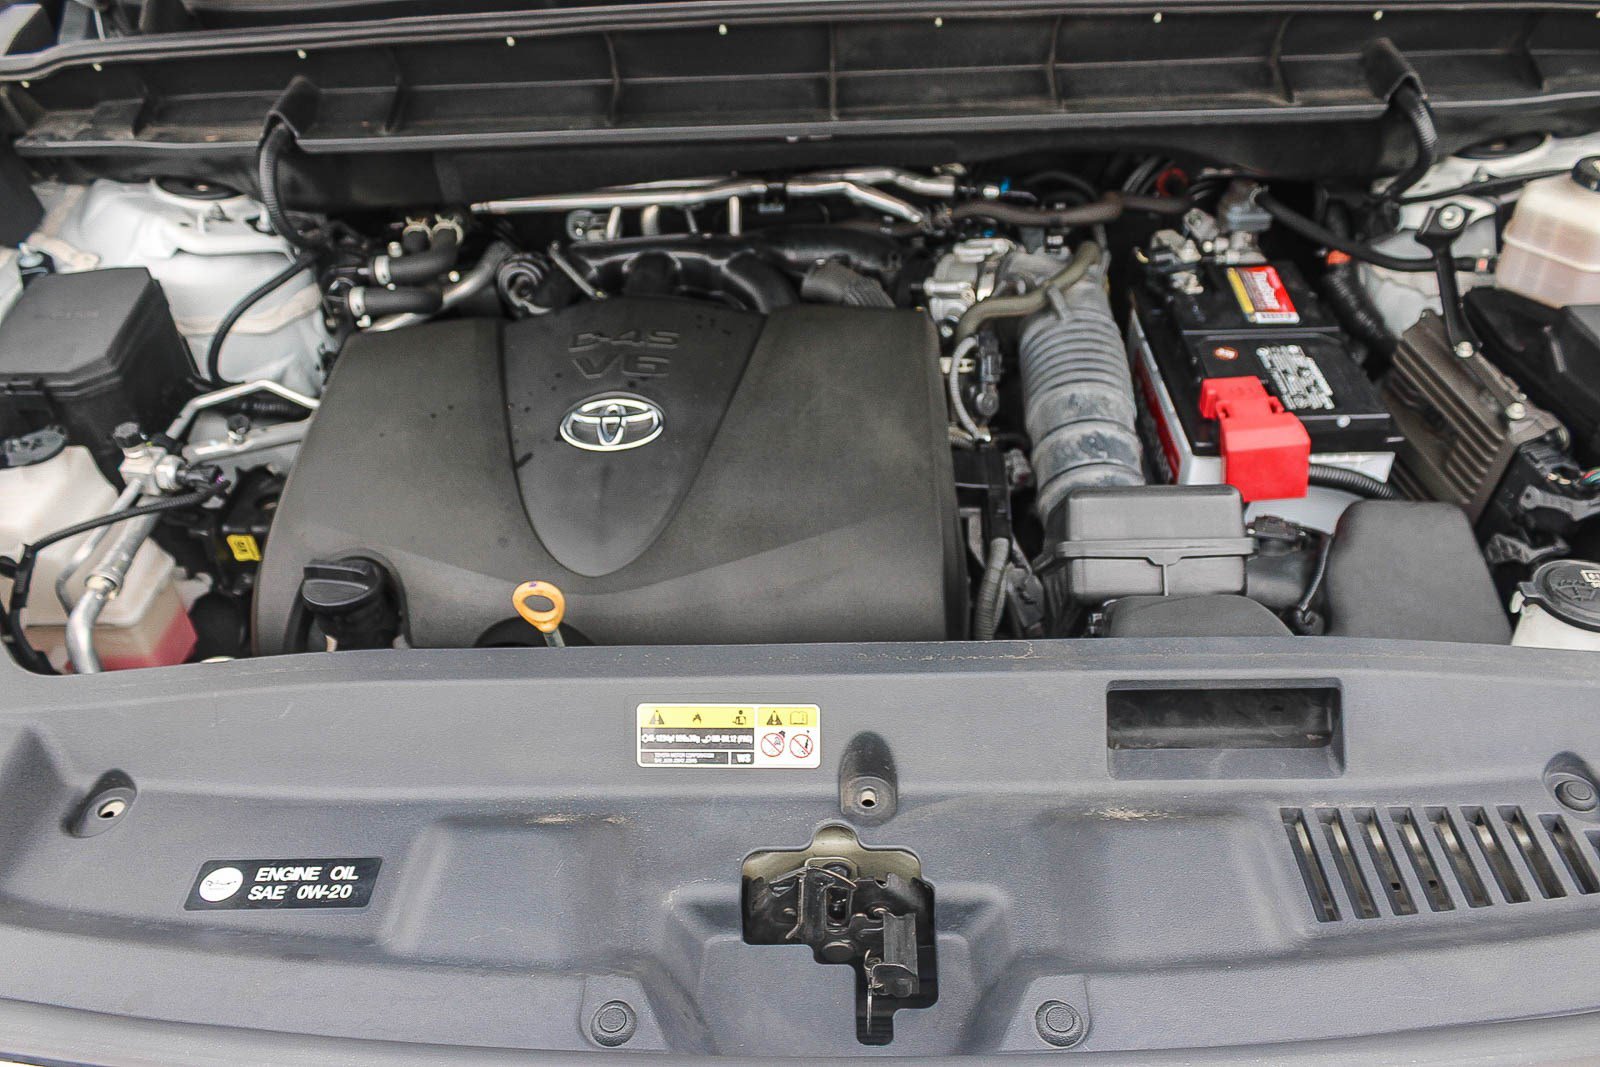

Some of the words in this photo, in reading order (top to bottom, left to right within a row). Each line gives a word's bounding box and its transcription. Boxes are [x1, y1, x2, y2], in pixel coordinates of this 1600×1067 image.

[254, 867, 322, 882] ENGINE
[329, 866, 359, 881] OIL
[247, 885, 289, 901] SAE
[296, 885, 353, 900] 0W-20
